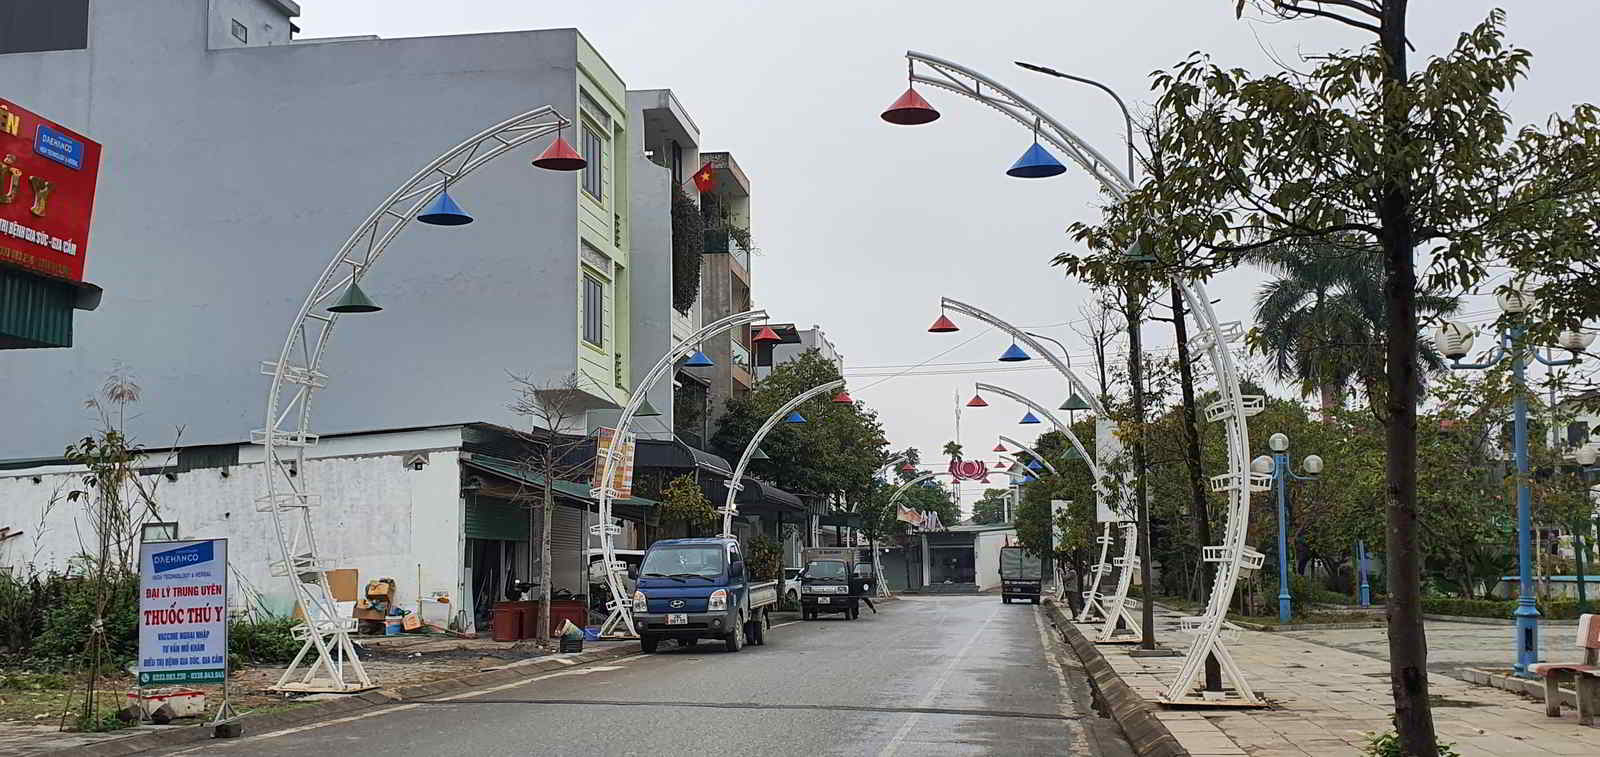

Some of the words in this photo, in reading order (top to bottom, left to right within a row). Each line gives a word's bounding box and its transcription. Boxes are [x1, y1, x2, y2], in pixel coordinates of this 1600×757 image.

[42, 134, 72, 152] DAEHANCO
[8, 220, 25, 238] BỆNH
[25, 227, 36, 242] GIA
[154, 553, 199, 564] DAEHANCO
[145, 588, 160, 600] ĐẠI
[161, 586, 171, 598] LÝ
[172, 585, 199, 597] TRUNG
[200, 582, 222, 596] UYÊN
[144, 602, 184, 625] THUỐC
[187, 603, 211, 623] THÚ
[215, 606, 223, 622] Y
